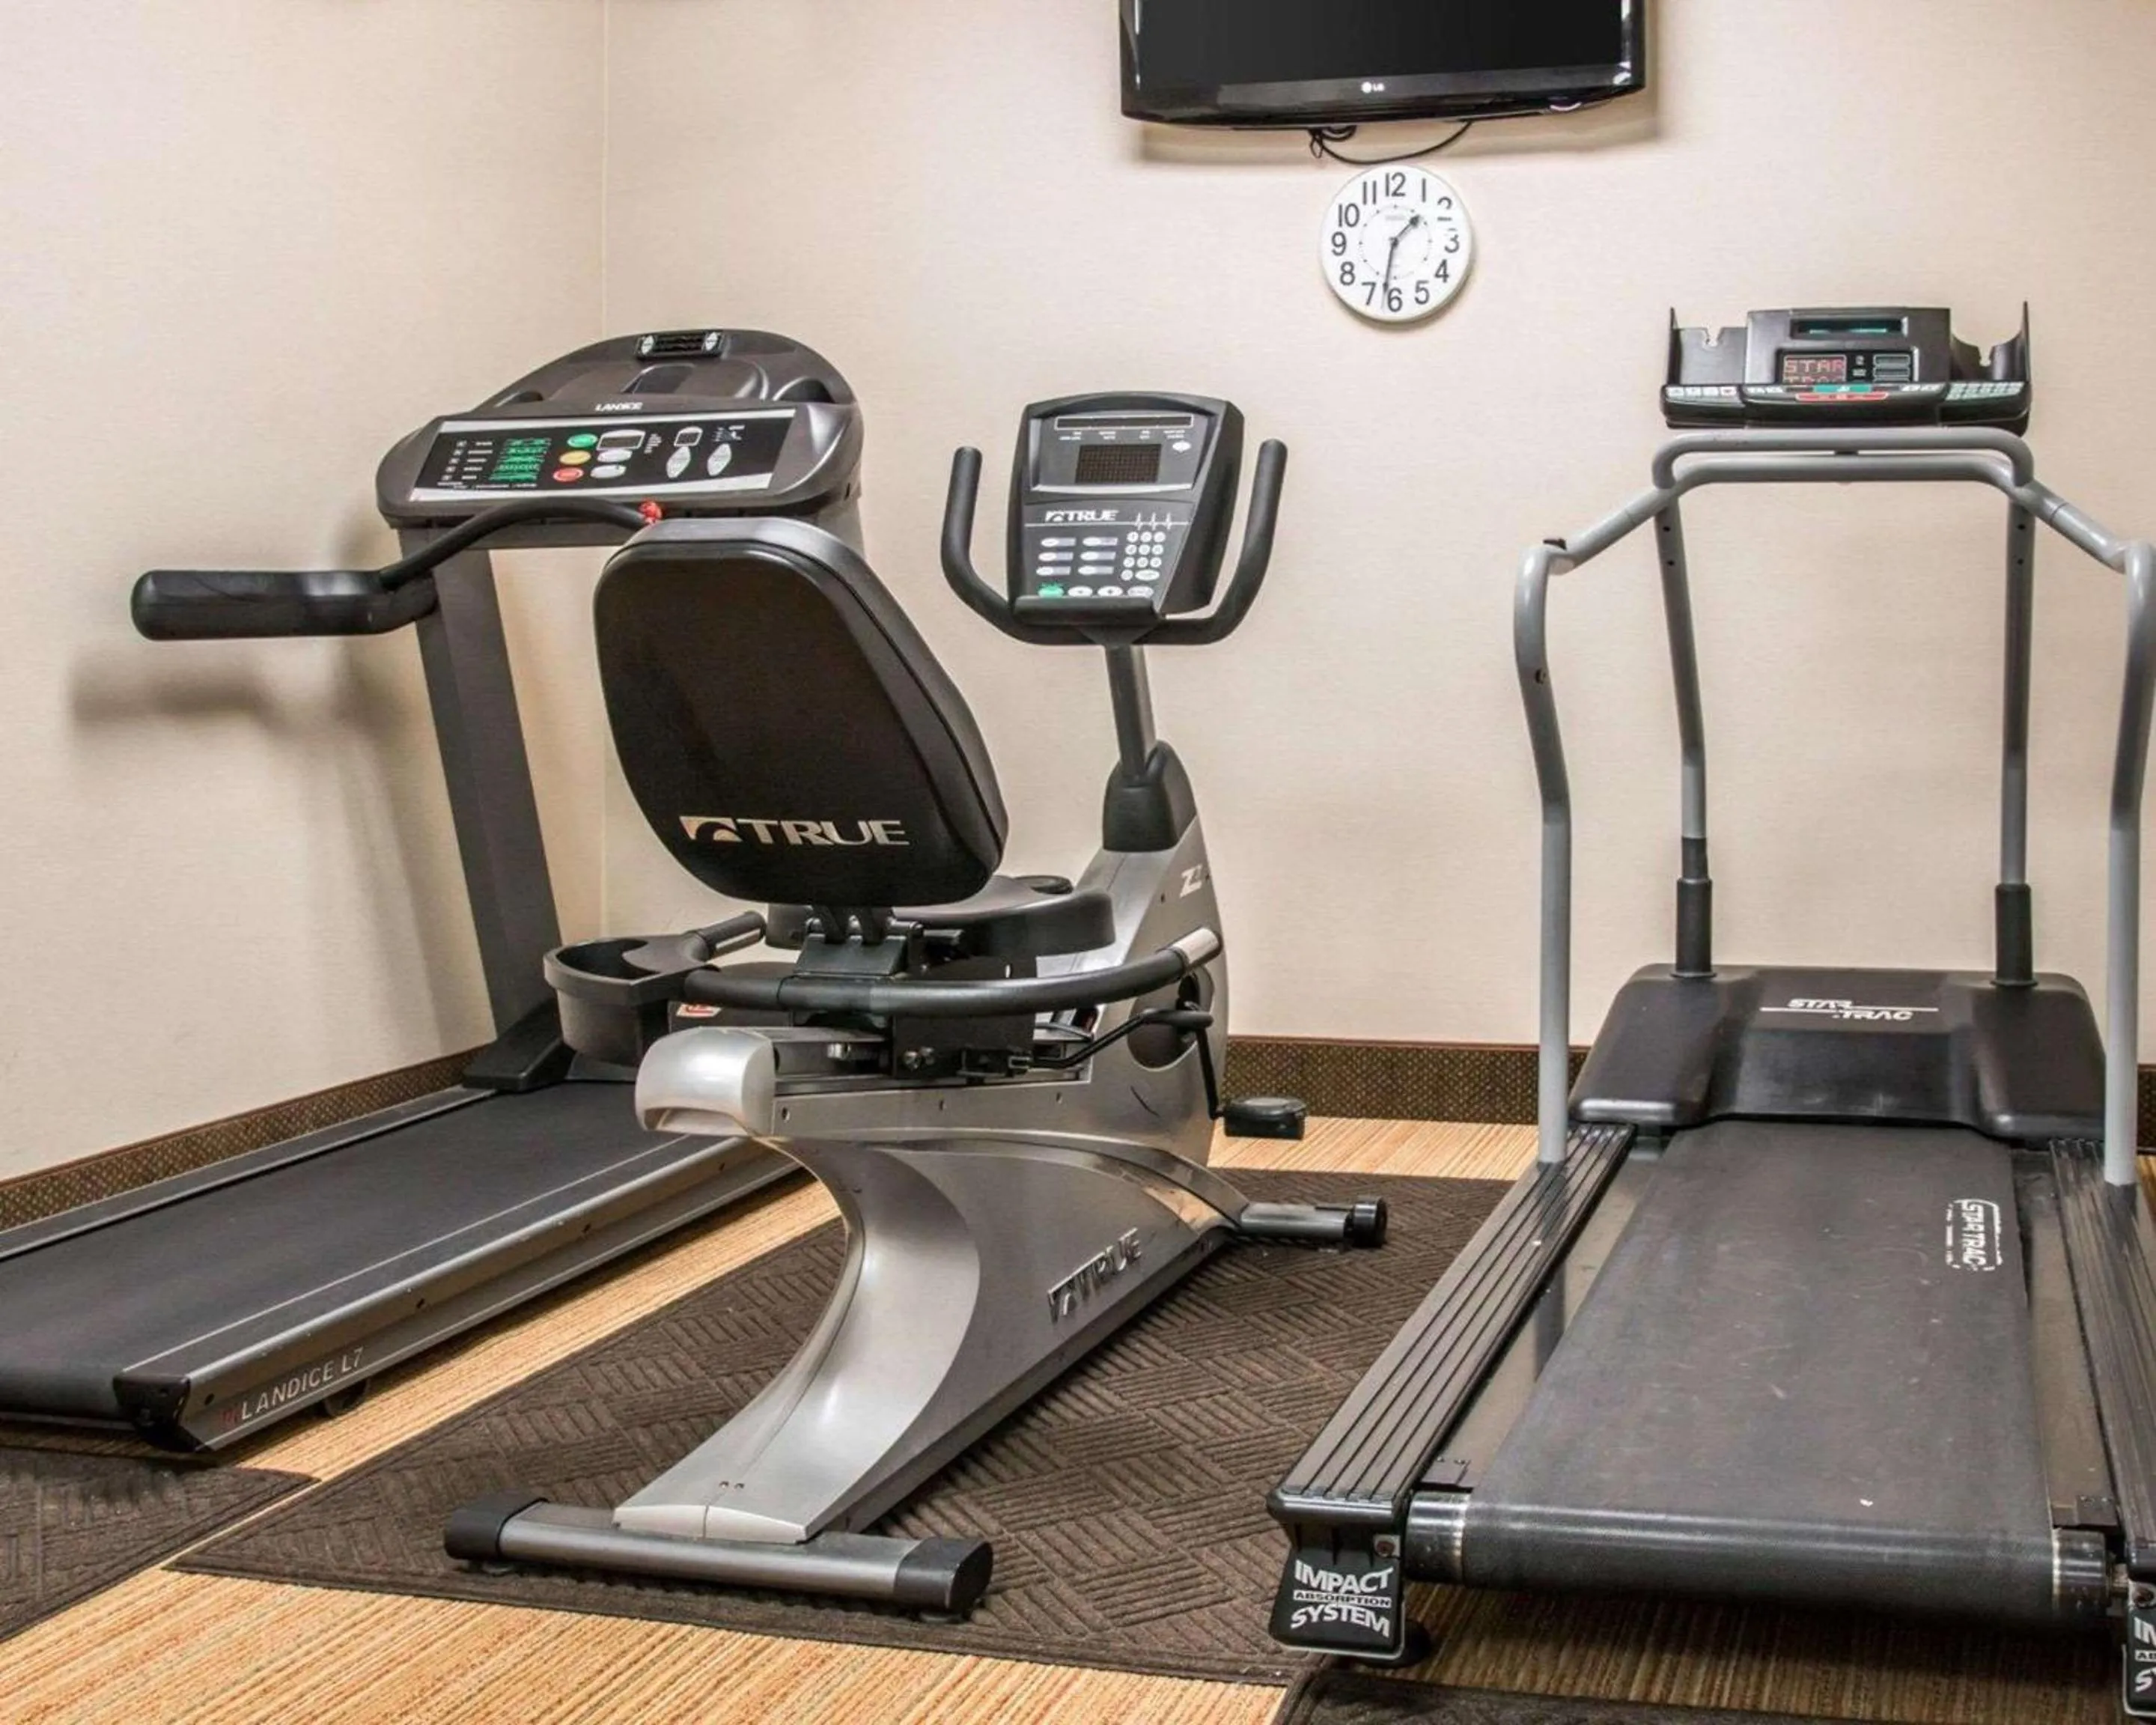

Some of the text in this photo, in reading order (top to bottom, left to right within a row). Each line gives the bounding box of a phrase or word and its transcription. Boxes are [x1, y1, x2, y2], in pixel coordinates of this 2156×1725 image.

[1362, 180, 1377, 204] 11
[1385, 172, 1406, 197] 12
[1422, 178, 1426, 202] 1
[1339, 203, 1360, 228] 10
[1437, 196, 1452, 222] 2
[1331, 231, 1347, 256] 9
[1444, 228, 1460, 253] 3
[1339, 262, 1356, 285] 8
[1434, 259, 1449, 283] 4
[1361, 282, 1377, 305] 7
[1387, 288, 1403, 312] 6
[1414, 280, 1429, 305] 5
[1063, 510, 1119, 522] TRUE
[737, 818, 910, 845] TRUE
[1788, 998, 1853, 1009] STAR
[241, 1347, 364, 1420] LANDICE L7
[1294, 1559, 1394, 1595] IMPACT
[1295, 1590, 1390, 1607] ABSORPTION
[1290, 1603, 1390, 1639] SYSTEM
